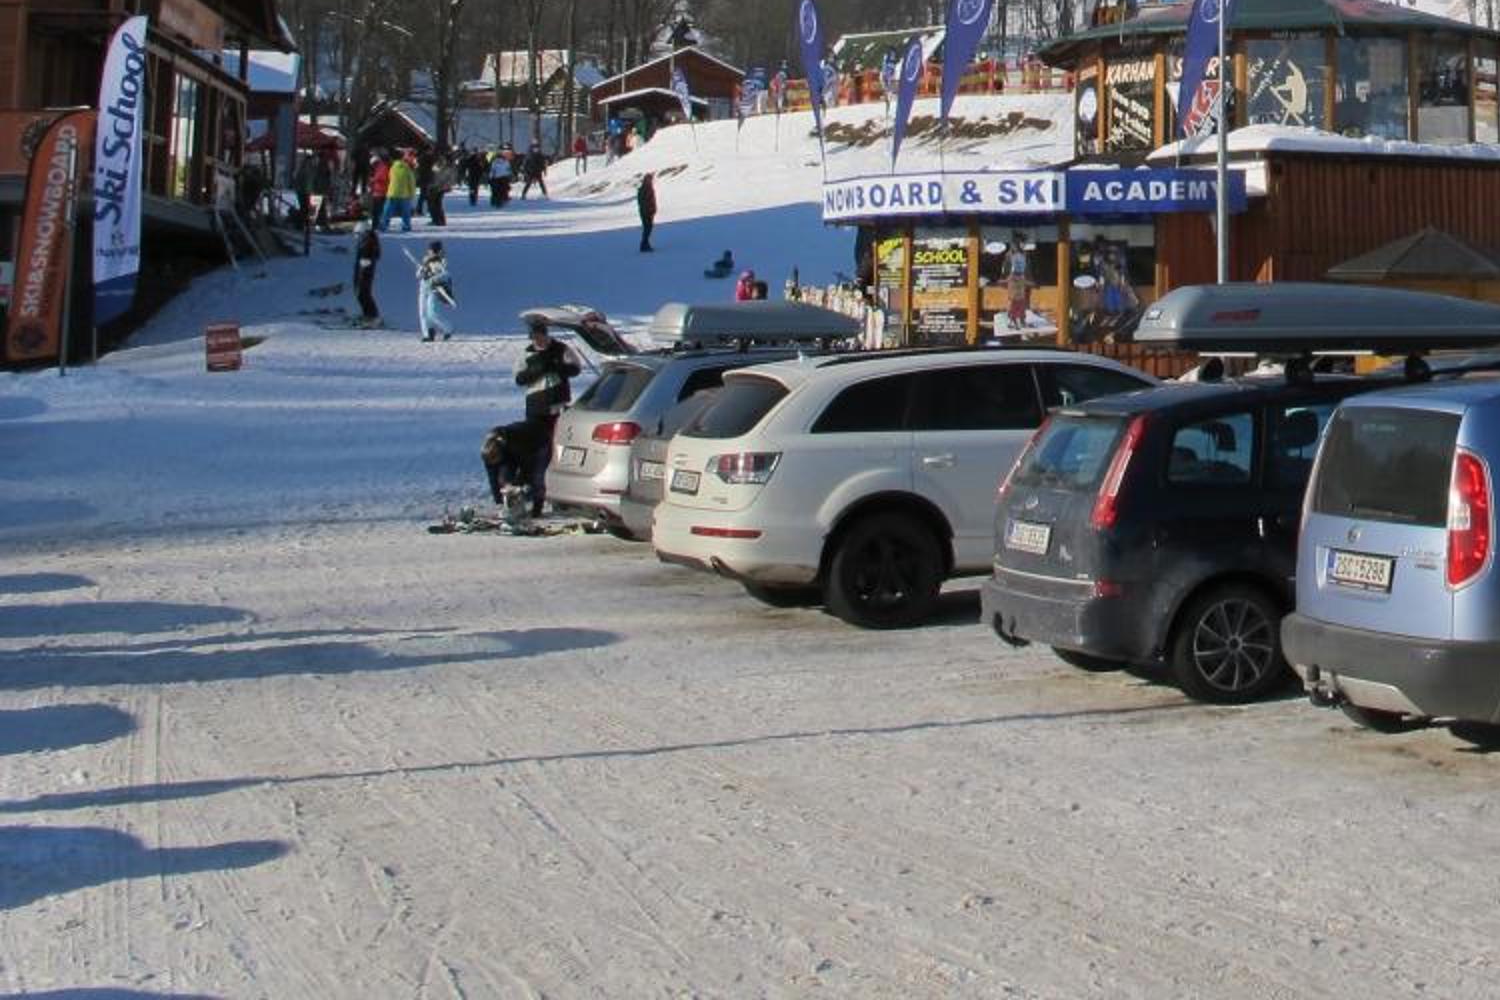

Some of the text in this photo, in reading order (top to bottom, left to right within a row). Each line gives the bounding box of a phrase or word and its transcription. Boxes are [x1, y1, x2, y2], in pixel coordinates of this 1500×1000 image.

[102, 32, 146, 163] School
[94, 167, 129, 226] Ski
[823, 181, 943, 213] NOWBOARD
[959, 179, 982, 204] &
[998, 179, 1059, 205] SKI
[914, 248, 966, 264] SCHOOL
